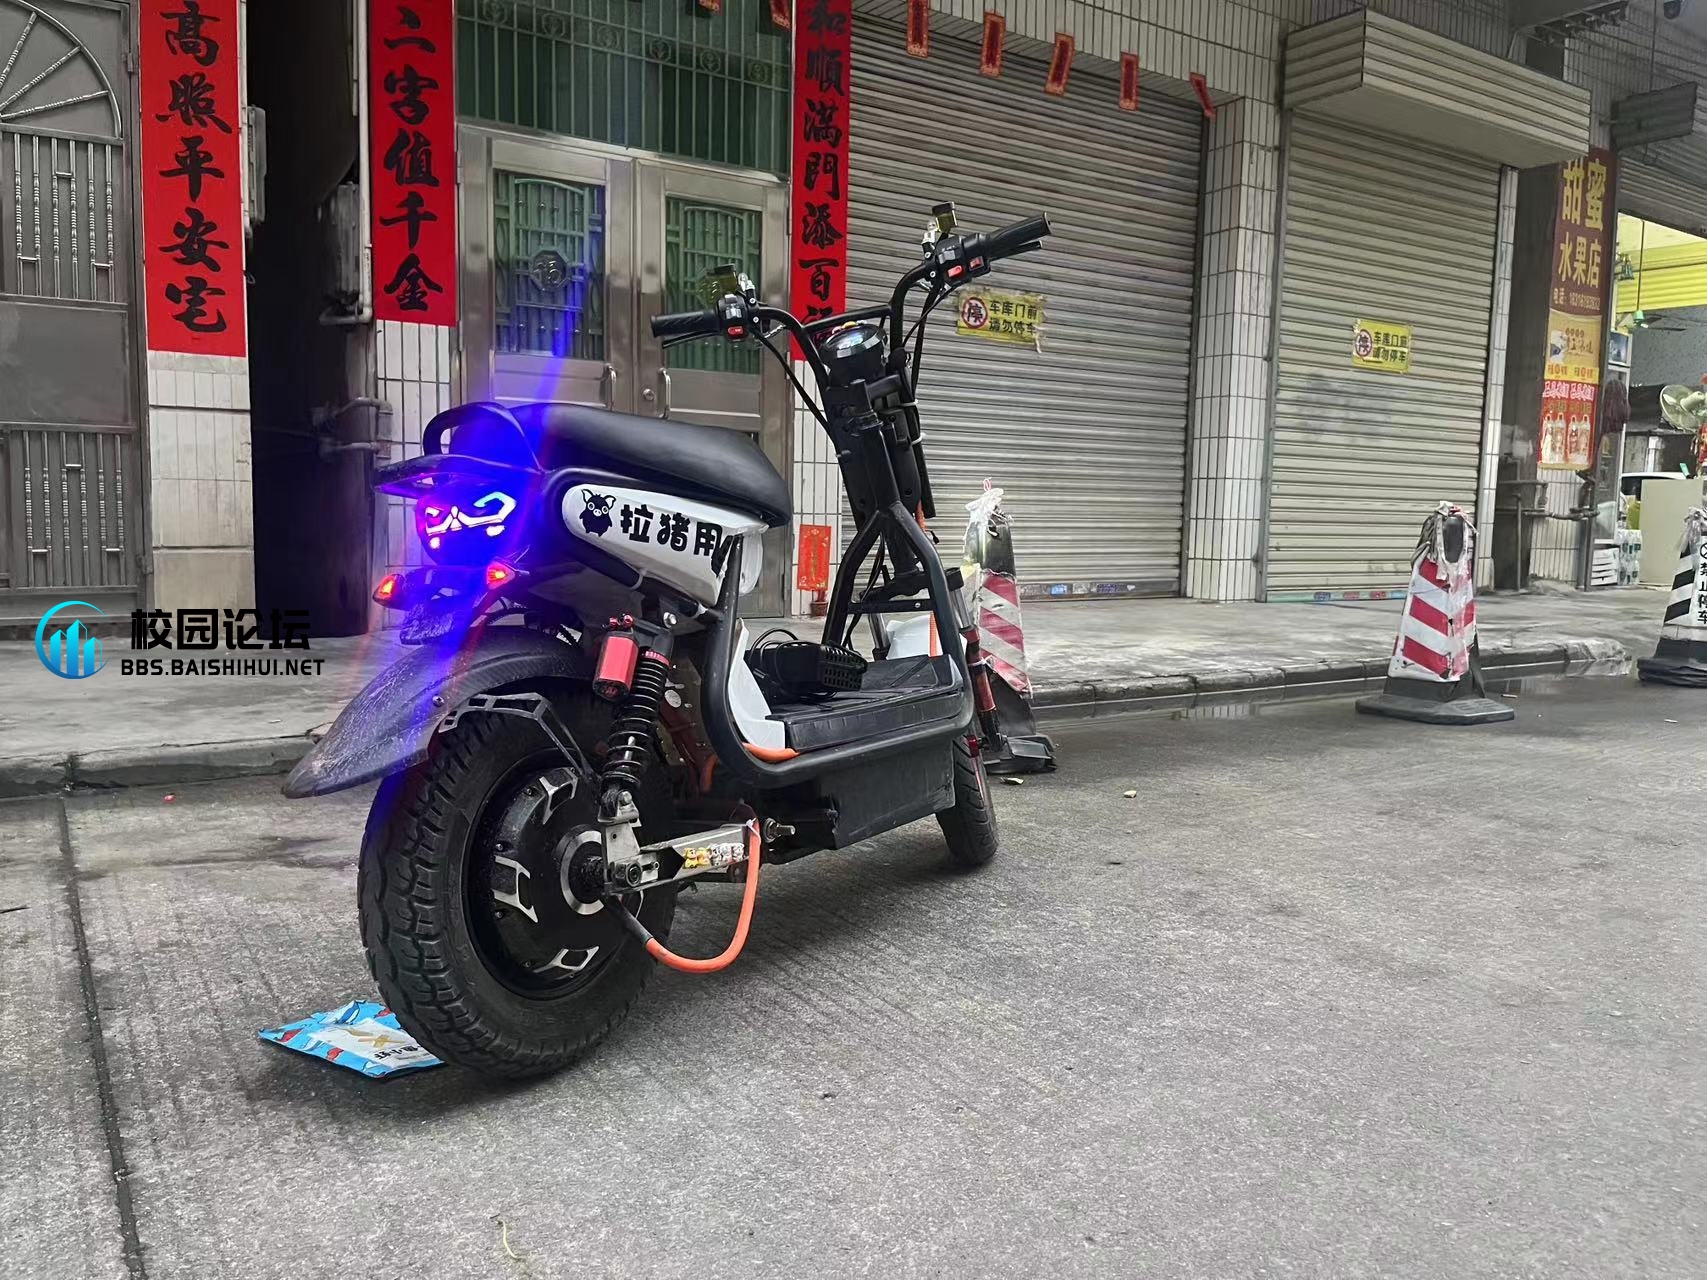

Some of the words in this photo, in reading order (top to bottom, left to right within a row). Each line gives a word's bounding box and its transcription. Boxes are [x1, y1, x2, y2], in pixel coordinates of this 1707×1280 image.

[1562, 157, 1607, 231] 甜蜜
[1558, 231, 1602, 288] 水果店
[989, 300, 1037, 320] 车库门前
[989, 317, 1037, 336] 请勿停车
